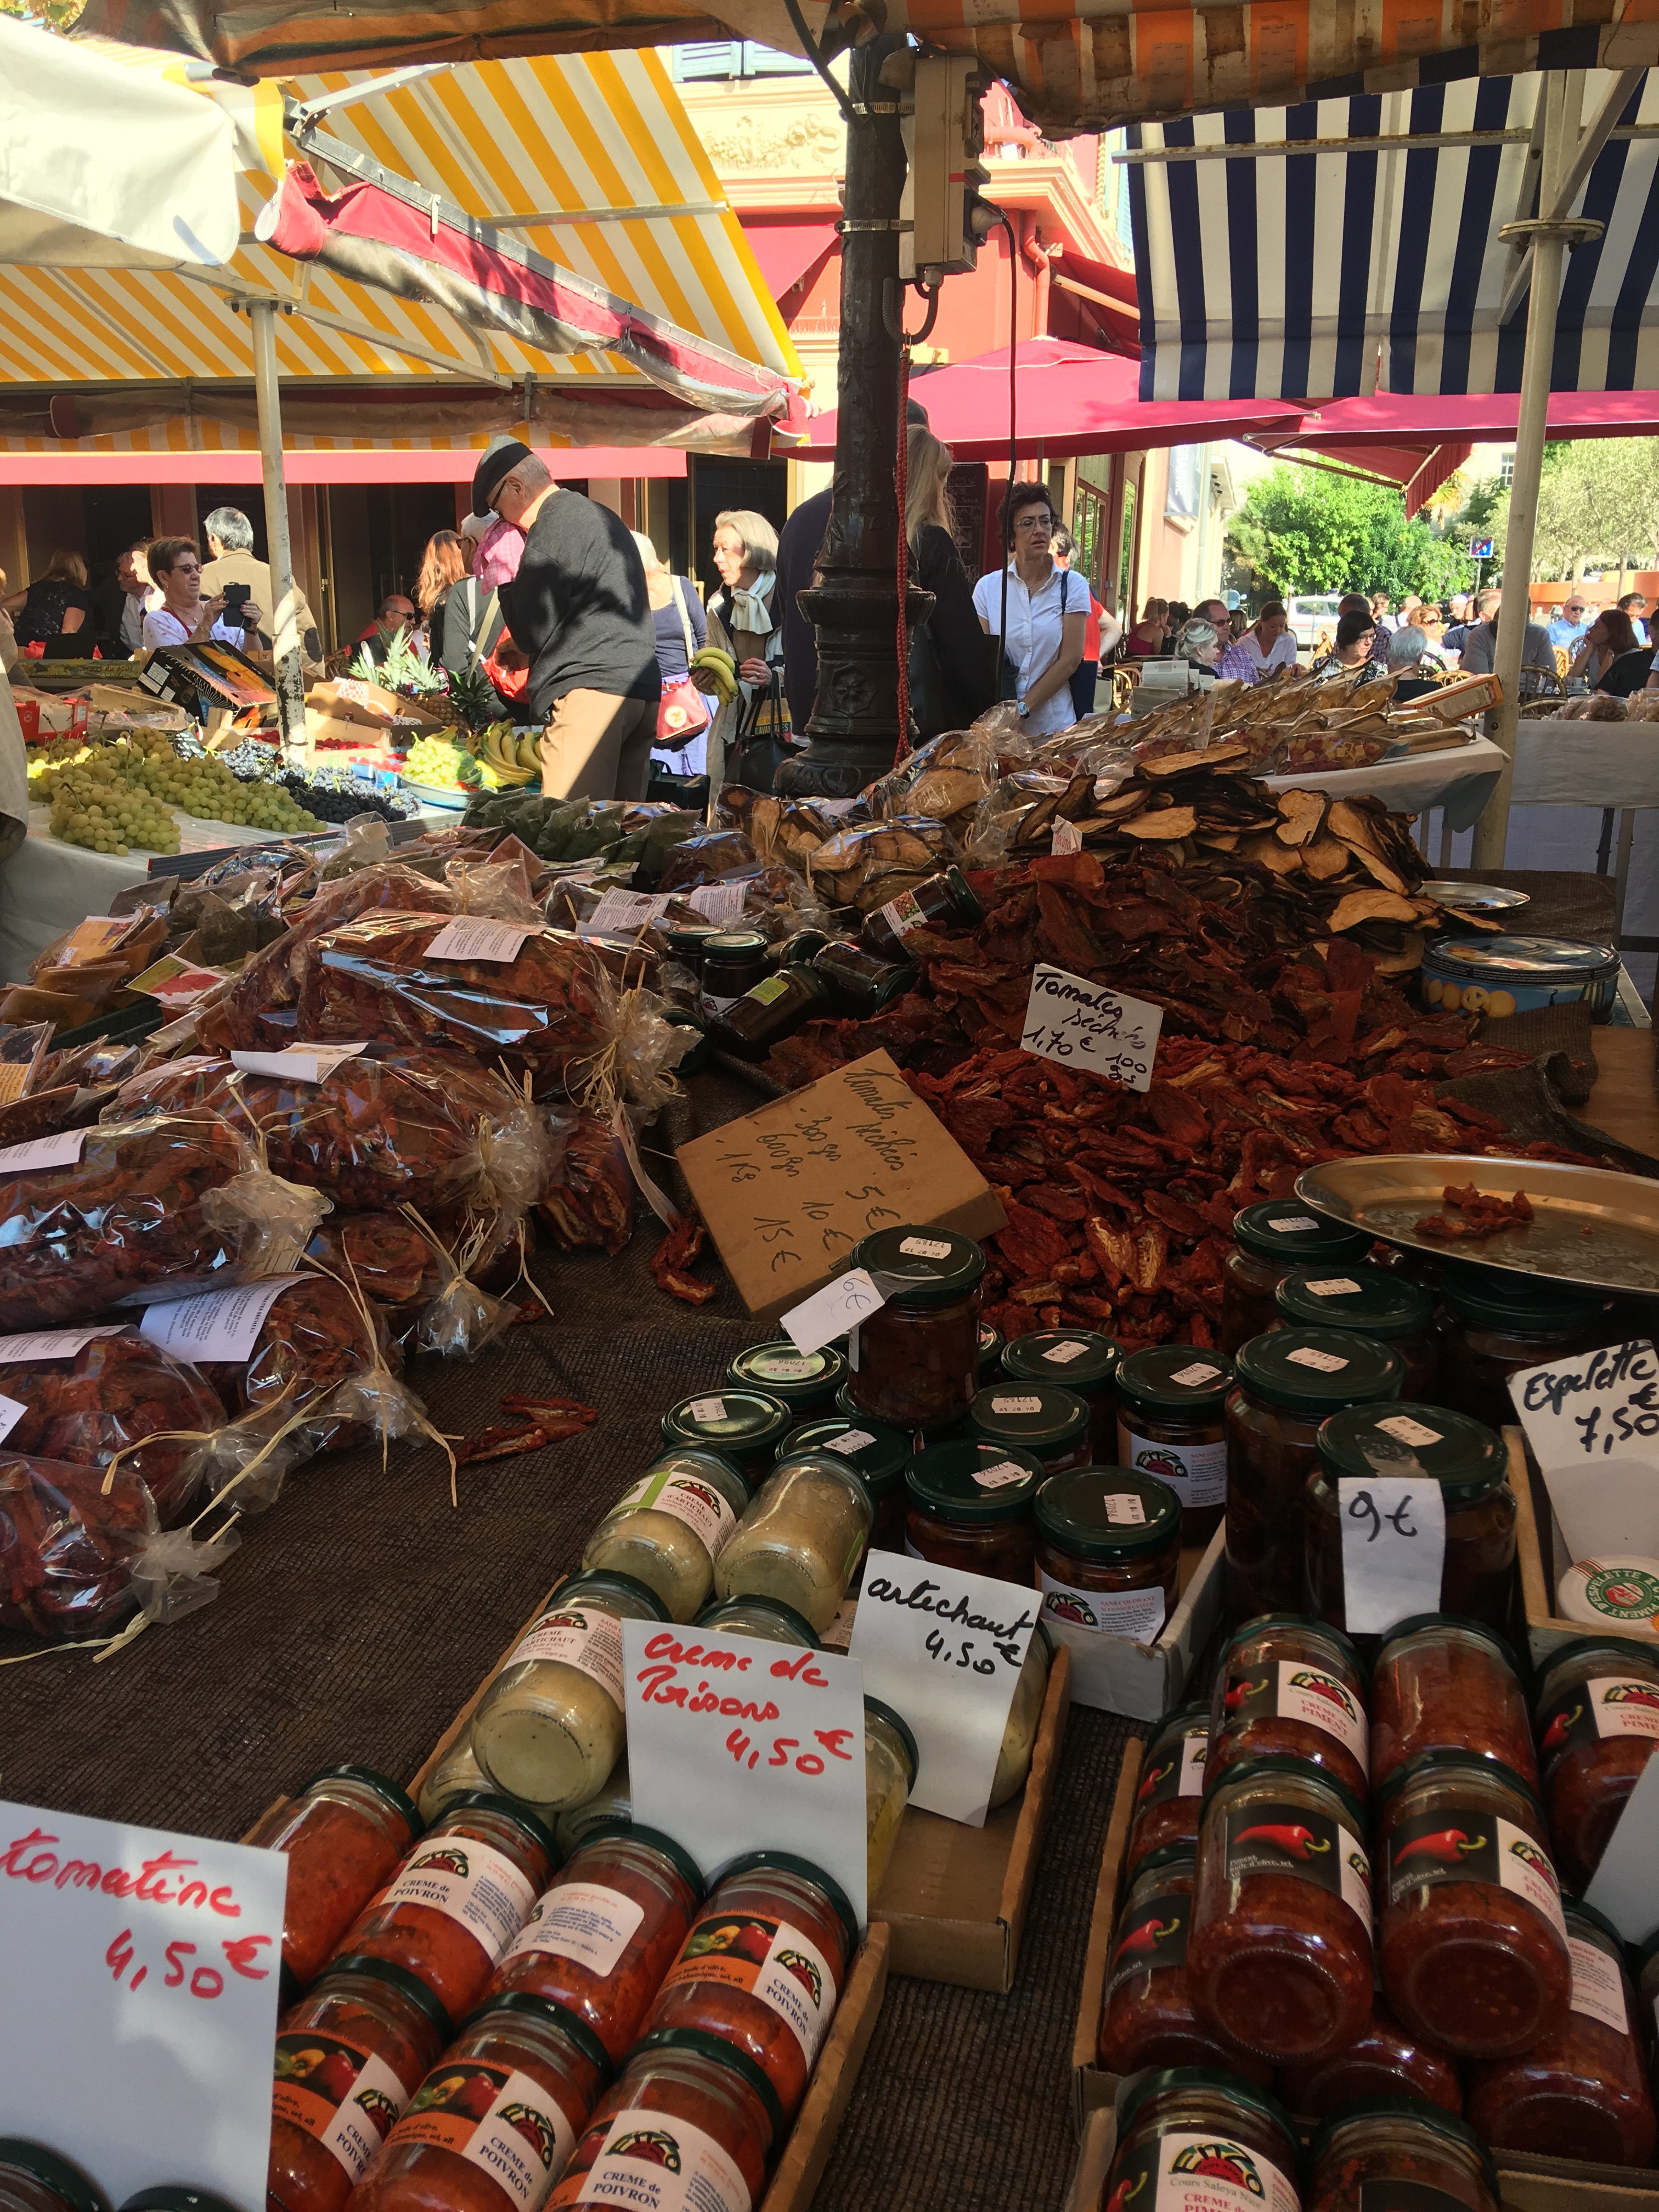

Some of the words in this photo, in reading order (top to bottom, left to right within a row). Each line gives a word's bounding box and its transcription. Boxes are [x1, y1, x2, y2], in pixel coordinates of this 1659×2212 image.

[1105, 1052, 1147, 1074] 100
[915, 1238, 945, 1249] 17185
[1524, 1341, 1658, 1415] Espelette
[680, 1493, 706, 1512] CREME
[770, 1652, 829, 1688] de
[1301, 1699, 1335, 1718] CREME
[1301, 1706, 1348, 1736] PIMENT
[394, 1888, 449, 1904] POIVRON
[403, 1880, 438, 1891] CREME
[439, 1884, 450, 1893] de
[774, 1978, 803, 2010] CREME
[766, 1985, 806, 2036] POIVRON
[479, 2145, 529, 2200] POIVRON
[490, 2136, 525, 2172] CREME
[524, 2171, 533, 2185] de
[602, 2171, 647, 2189] CREME
[648, 2184, 661, 2195] de
[1170, 2177, 1200, 2187] Cours
[1204, 2180, 1237, 2197] Saleya
[592, 2183, 661, 2210] POIVRON
[1184, 2193, 1231, 2209] CREME
